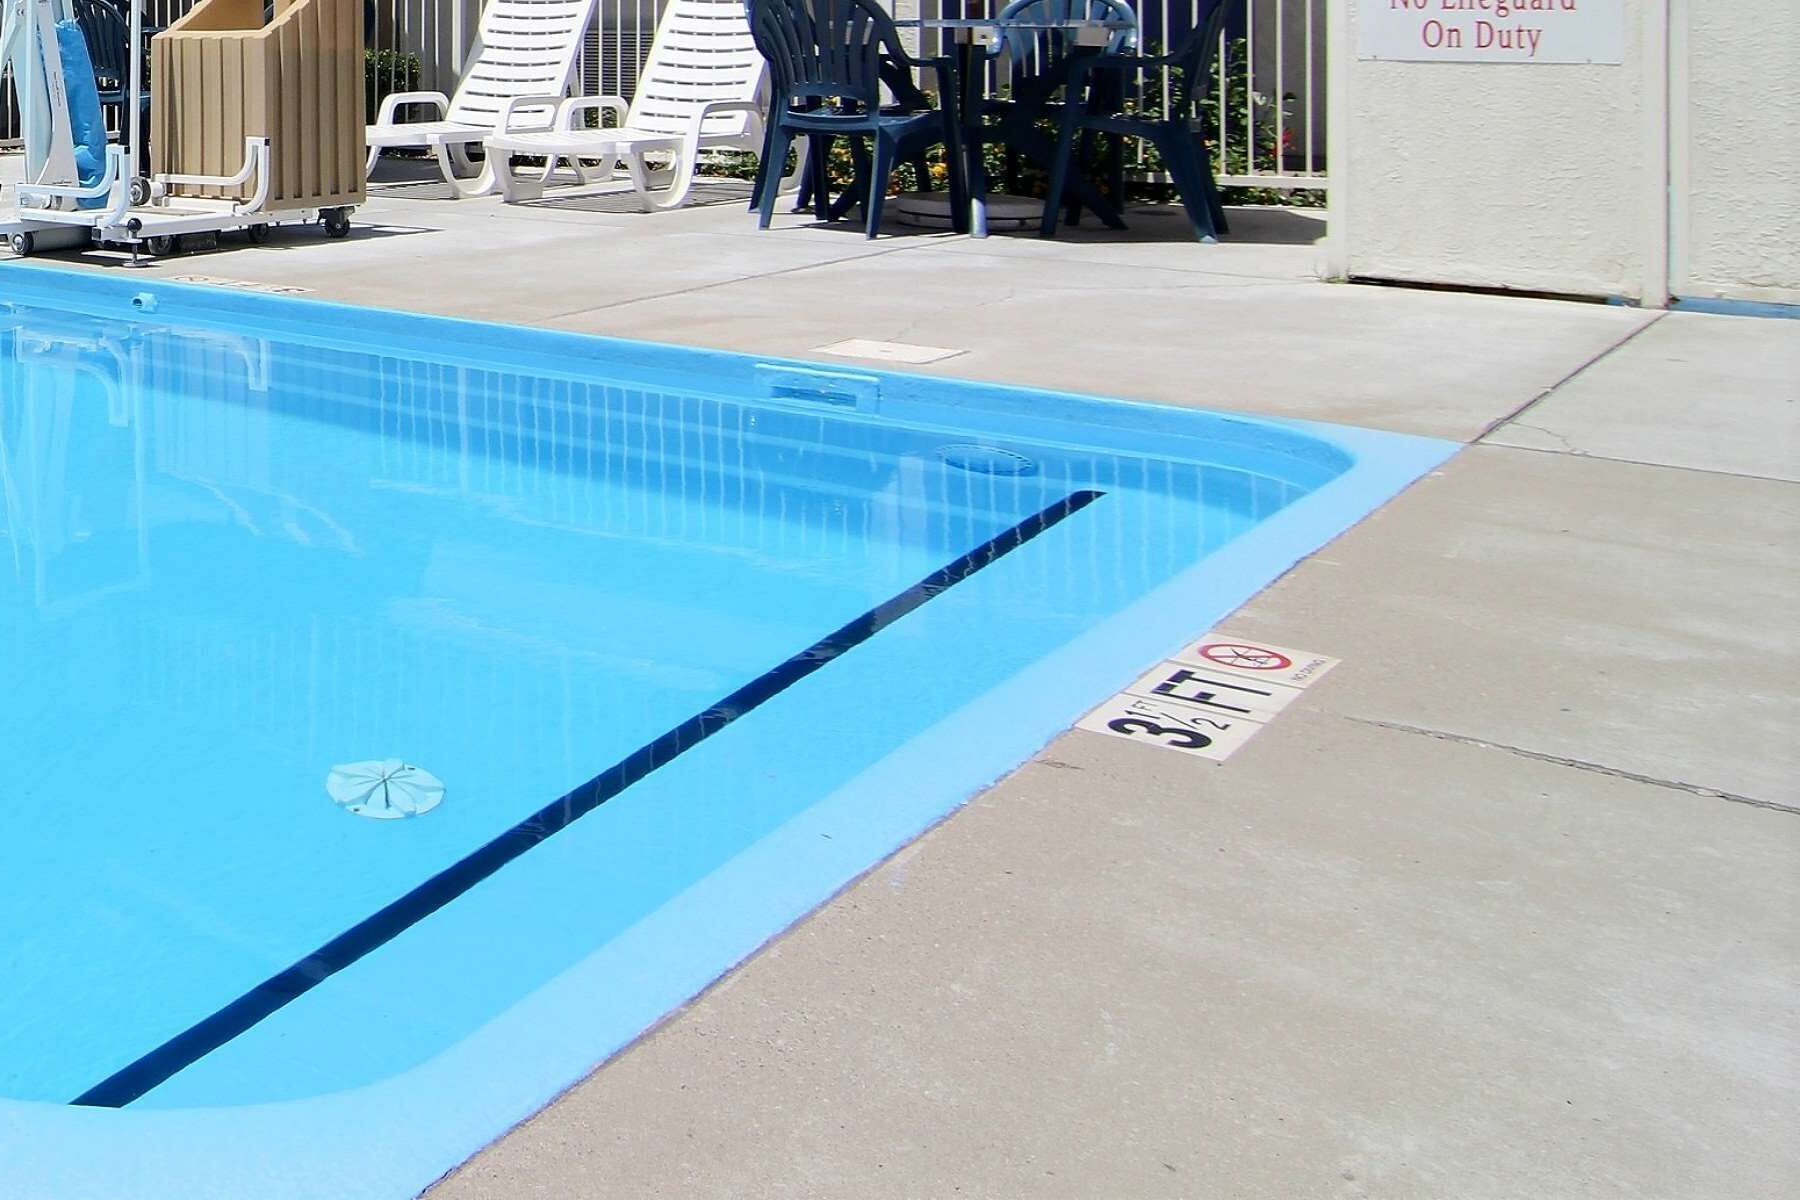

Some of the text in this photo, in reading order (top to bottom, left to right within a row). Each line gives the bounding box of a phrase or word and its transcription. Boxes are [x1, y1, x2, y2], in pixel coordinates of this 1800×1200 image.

[1422, 19, 1543, 57] On Duty
[1151, 670, 1272, 714] FT
